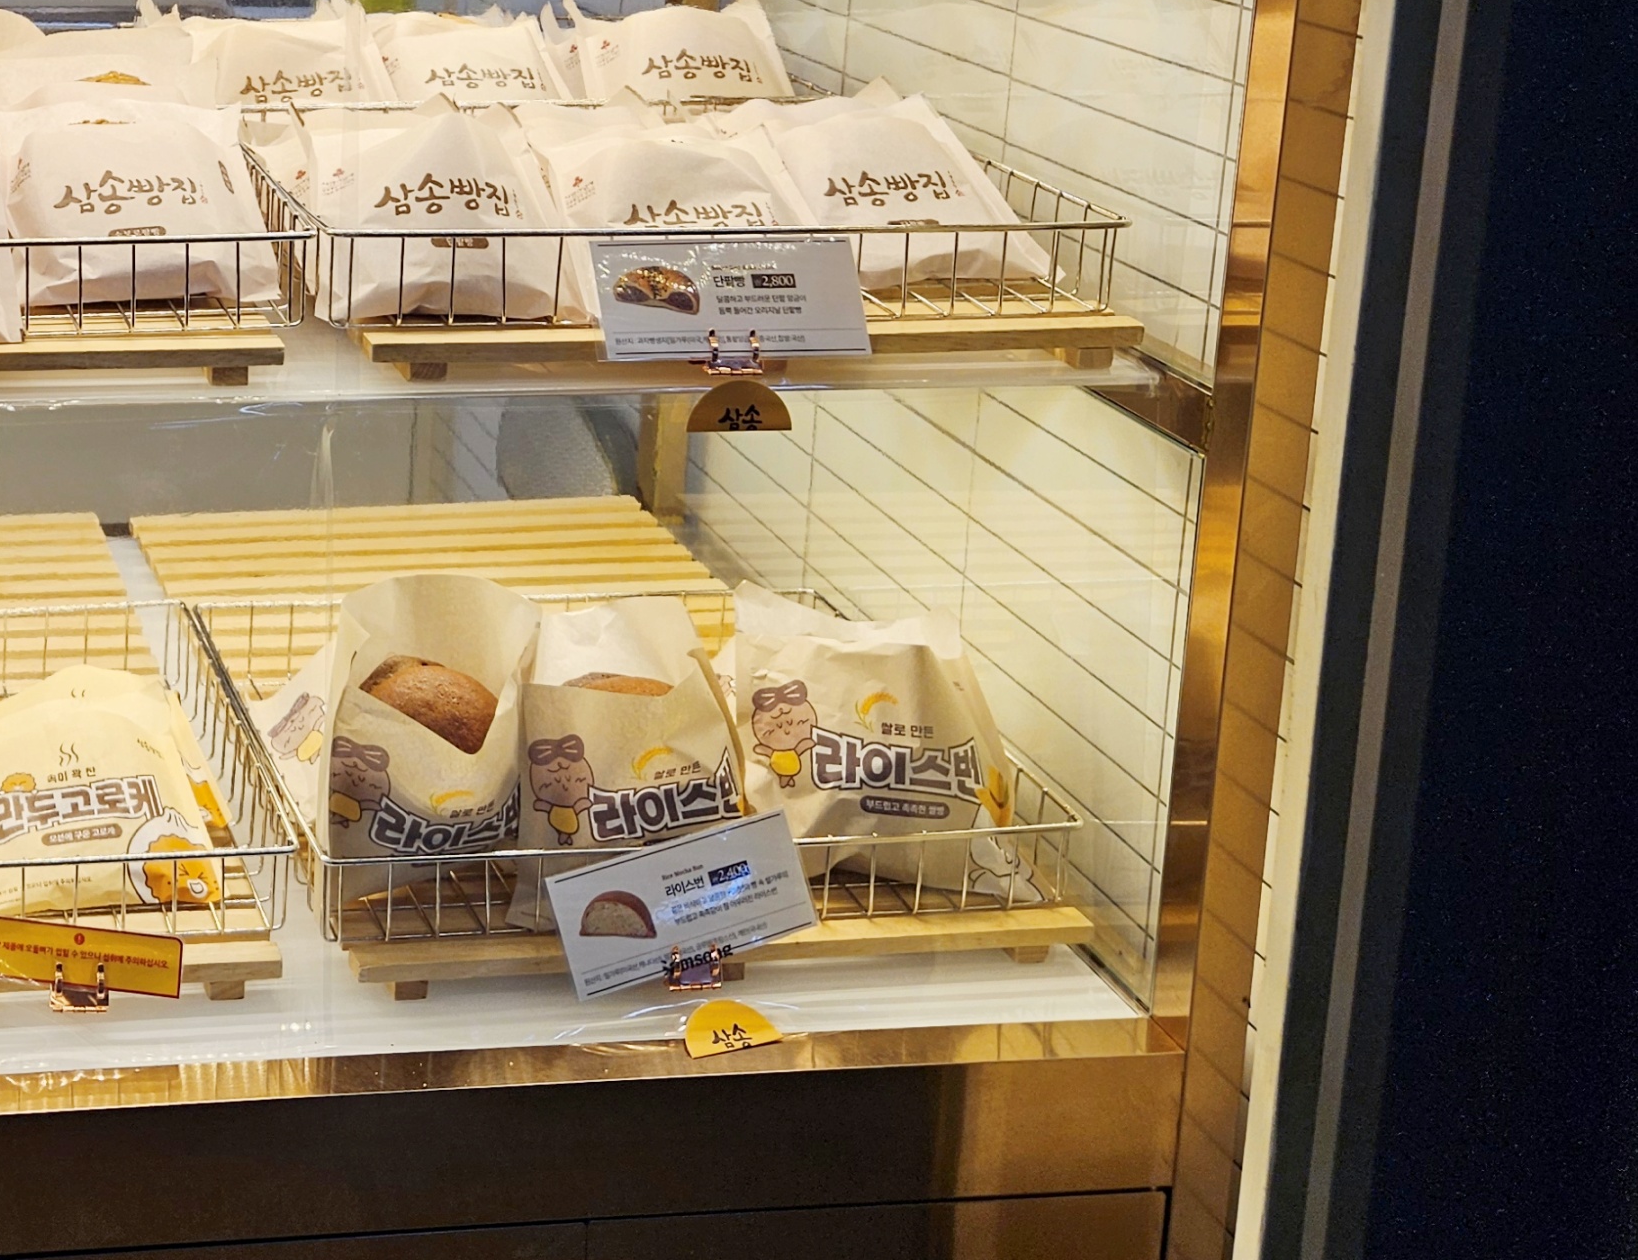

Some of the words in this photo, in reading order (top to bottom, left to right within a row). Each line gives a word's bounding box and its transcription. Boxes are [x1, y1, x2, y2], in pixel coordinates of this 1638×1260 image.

[425, 62, 537, 89] 삼송빵집
[641, 47, 754, 82] 삼송빵집
[240, 69, 352, 103] 삼송빵집
[53, 169, 198, 216] 삼송빵집
[374, 172, 511, 218] 삼송빵집
[824, 170, 952, 207] 삼송빵집
[713, 275, 745, 288] 단팥빵
[718, 404, 763, 431] 삼송
[881, 722, 906, 737] 쌀로
[910, 724, 935, 739] 만든
[681, 764, 701, 775] 만든
[814, 733, 983, 800] 라이스번
[865, 799, 900, 813] 부드럽고
[665, 876, 705, 897] 라이스번
[71, 949, 78, 959] 수
[80, 950, 102, 961] 있으니
[712, 1023, 753, 1049] 삼송
